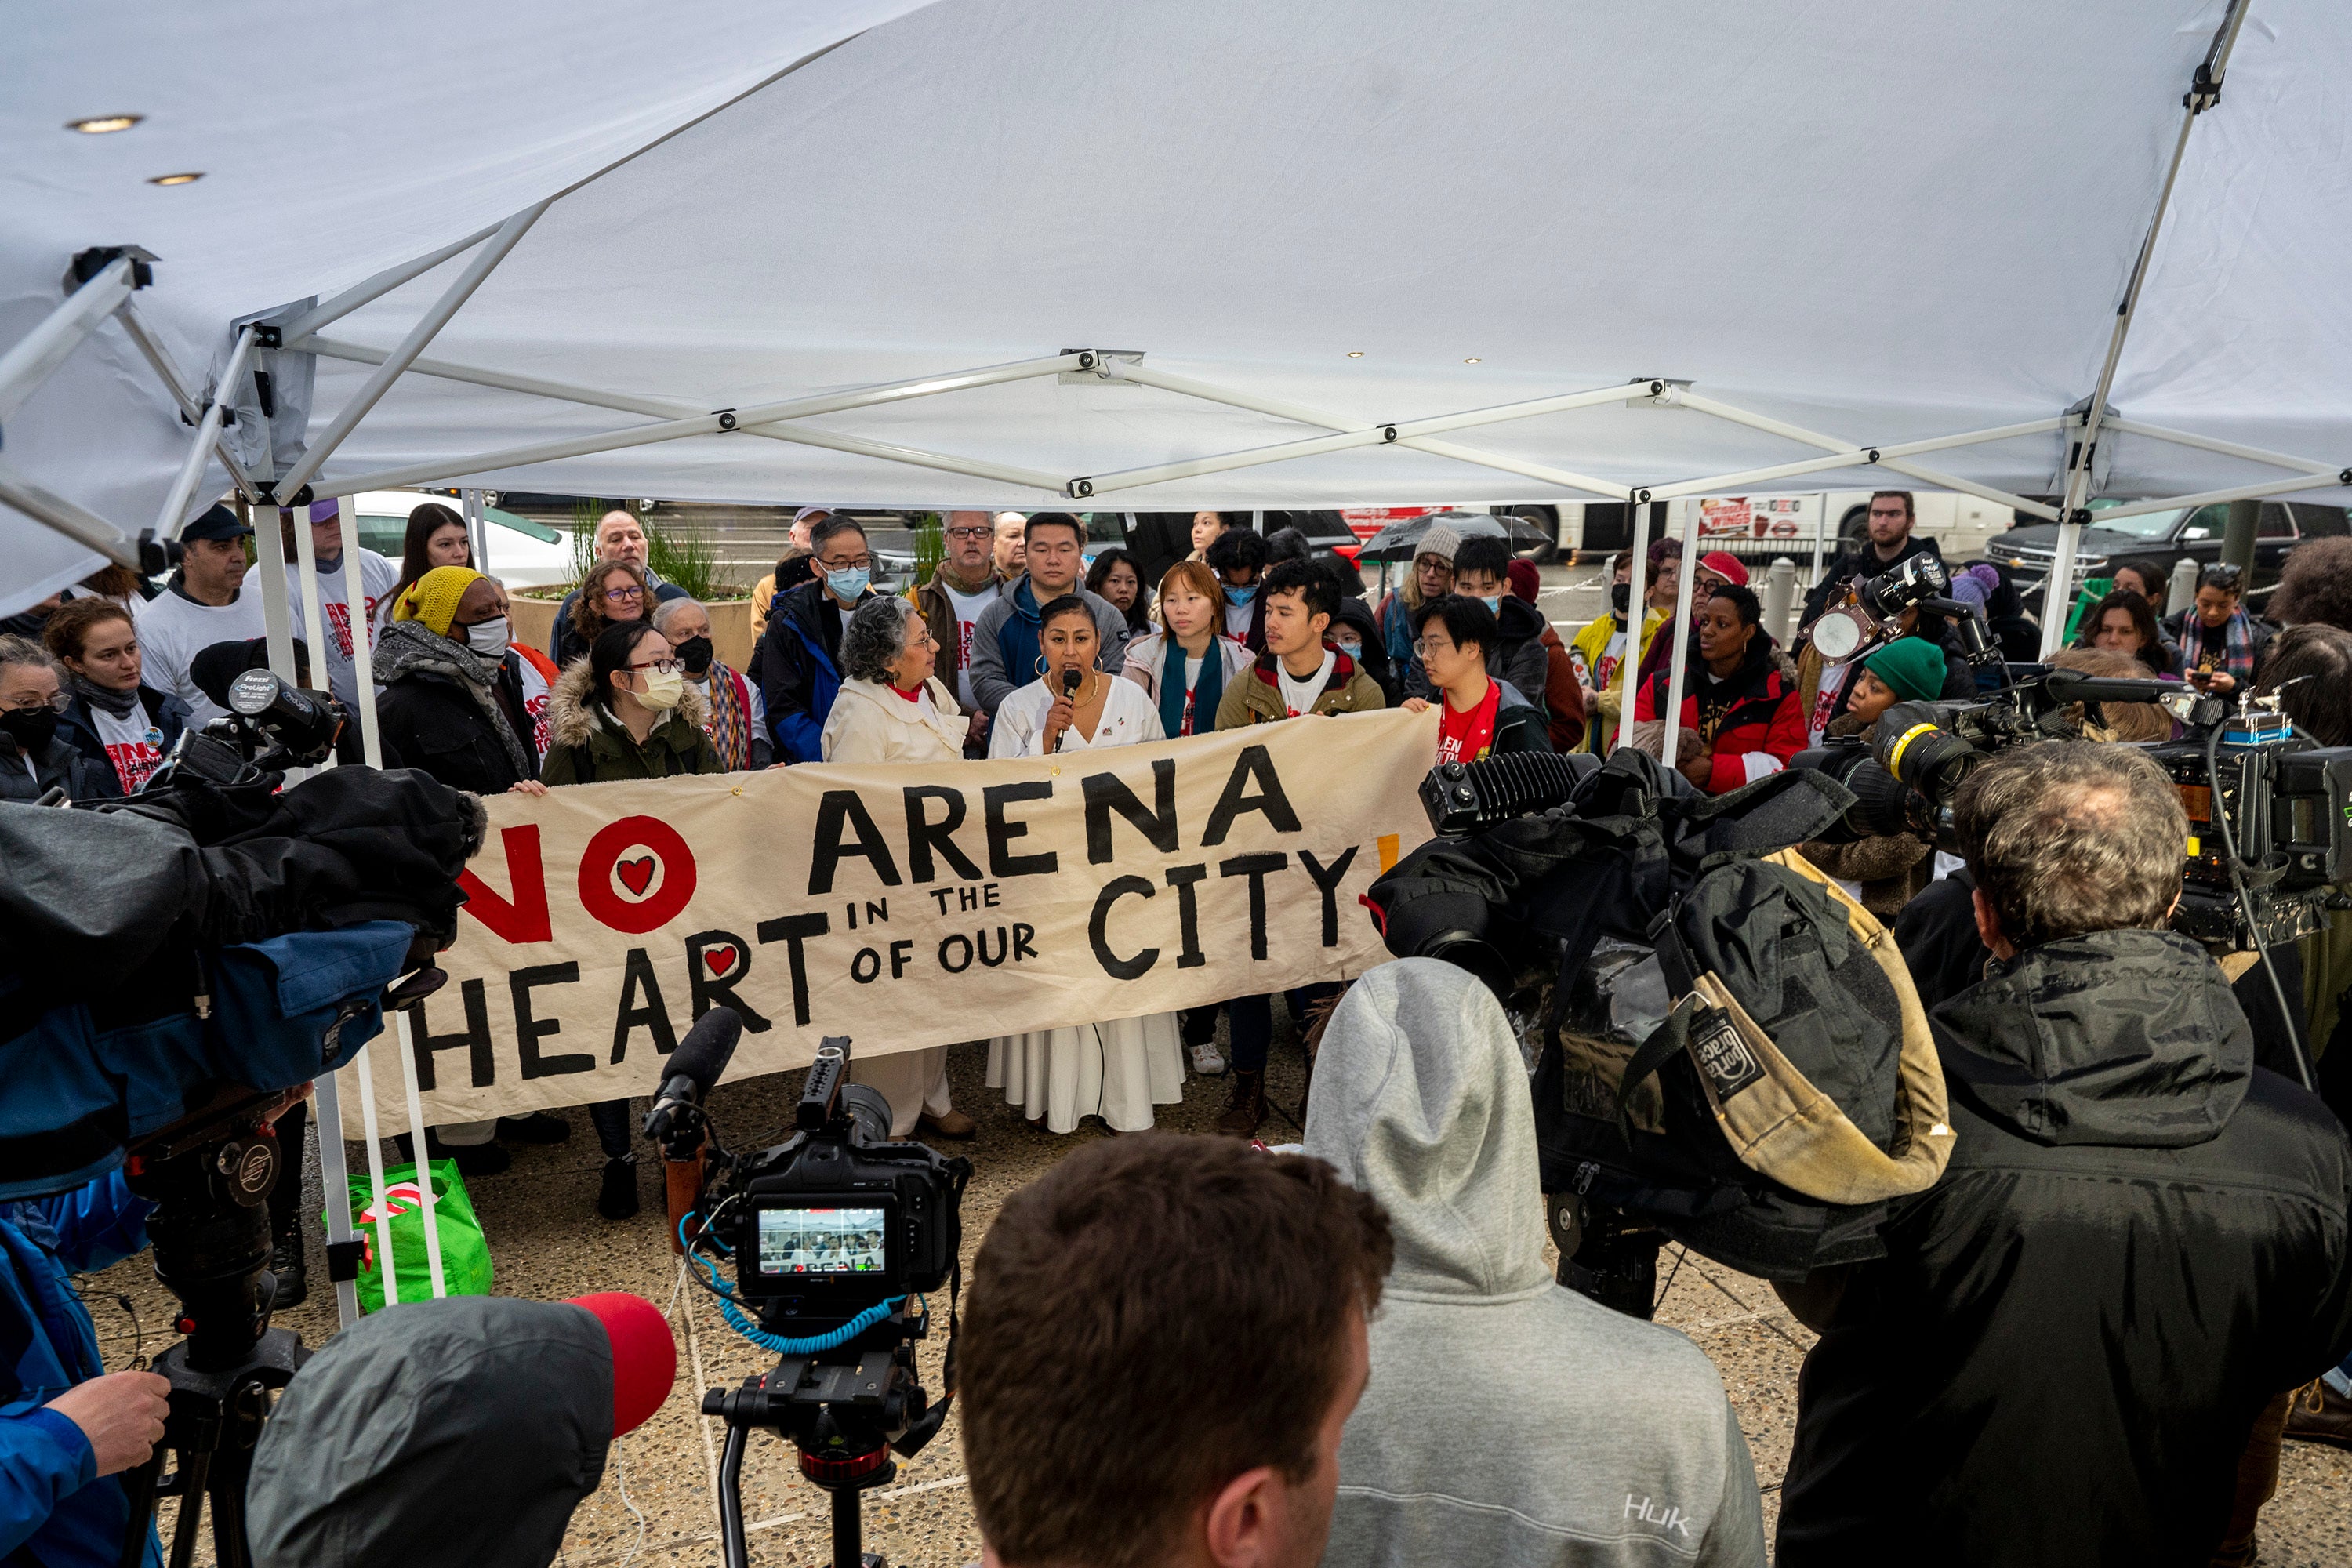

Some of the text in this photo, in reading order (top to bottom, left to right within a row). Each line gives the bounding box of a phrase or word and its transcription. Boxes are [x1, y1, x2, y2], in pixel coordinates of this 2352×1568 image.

[1711, 513, 1751, 527] WINGS
[285, 691, 310, 713] ProLight
[456, 745, 1302, 945] NO ARENA
[847, 883, 1000, 930] IN THE
[412, 911, 831, 1092] HEART
[851, 940, 913, 984] OF
[938, 924, 1037, 973] OUR
